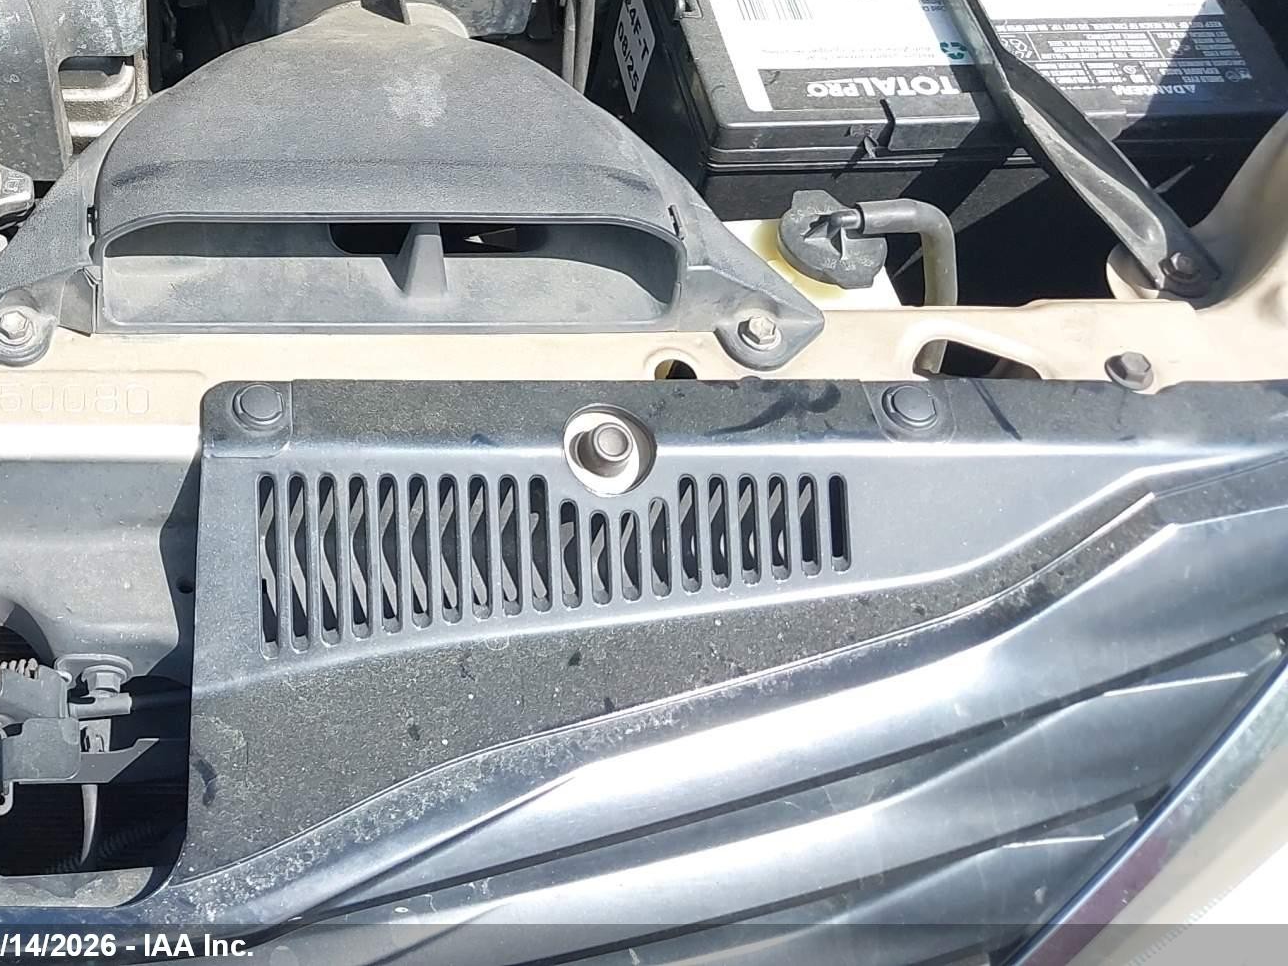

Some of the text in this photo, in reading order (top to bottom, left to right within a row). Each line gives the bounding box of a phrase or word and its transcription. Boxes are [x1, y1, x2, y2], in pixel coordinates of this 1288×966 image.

[617, 20, 639, 93] 08/25
[806, 75, 961, 97] TOTALPRO
[0, 384, 150, 414] 50080
